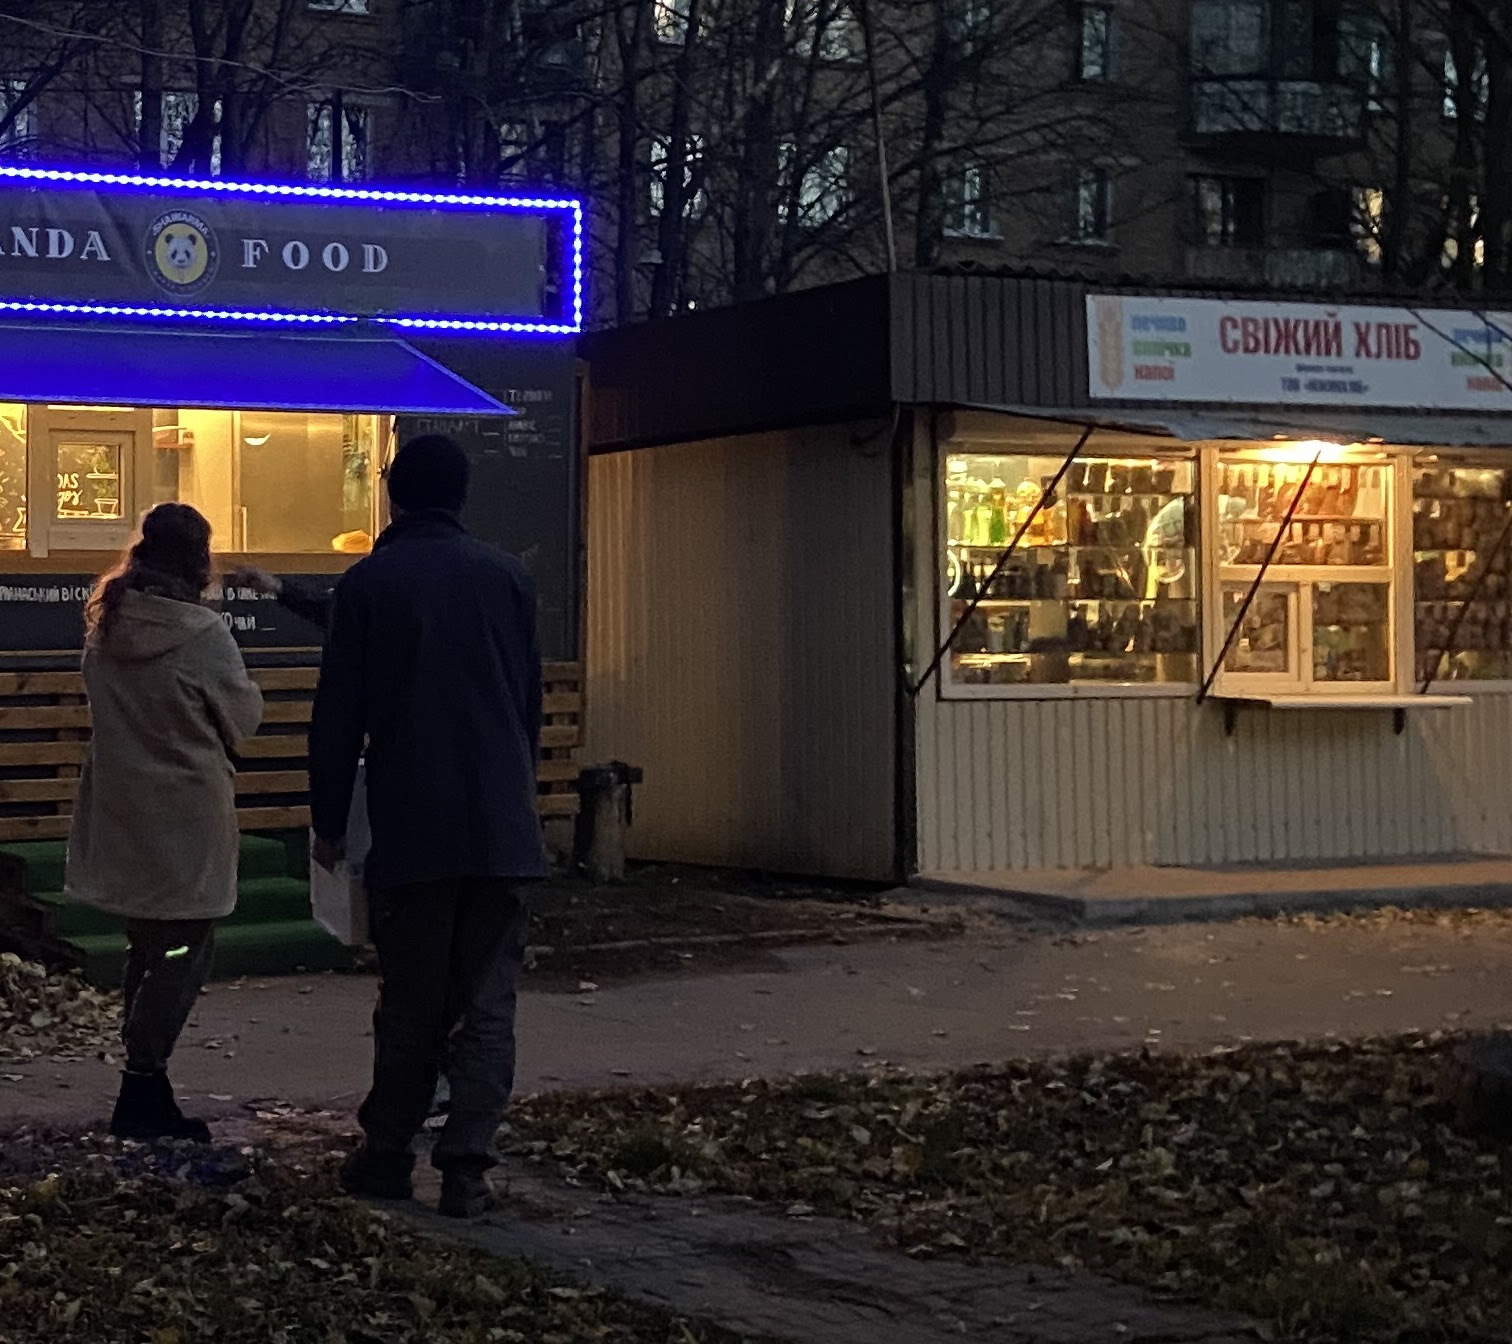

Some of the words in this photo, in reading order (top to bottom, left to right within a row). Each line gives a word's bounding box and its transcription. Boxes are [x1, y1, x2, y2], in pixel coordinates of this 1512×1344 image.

[241, 238, 388, 272] FOOD
[1219, 309, 1343, 357] СВІЖИЙ
[1353, 321, 1422, 361] ХЛІБ
